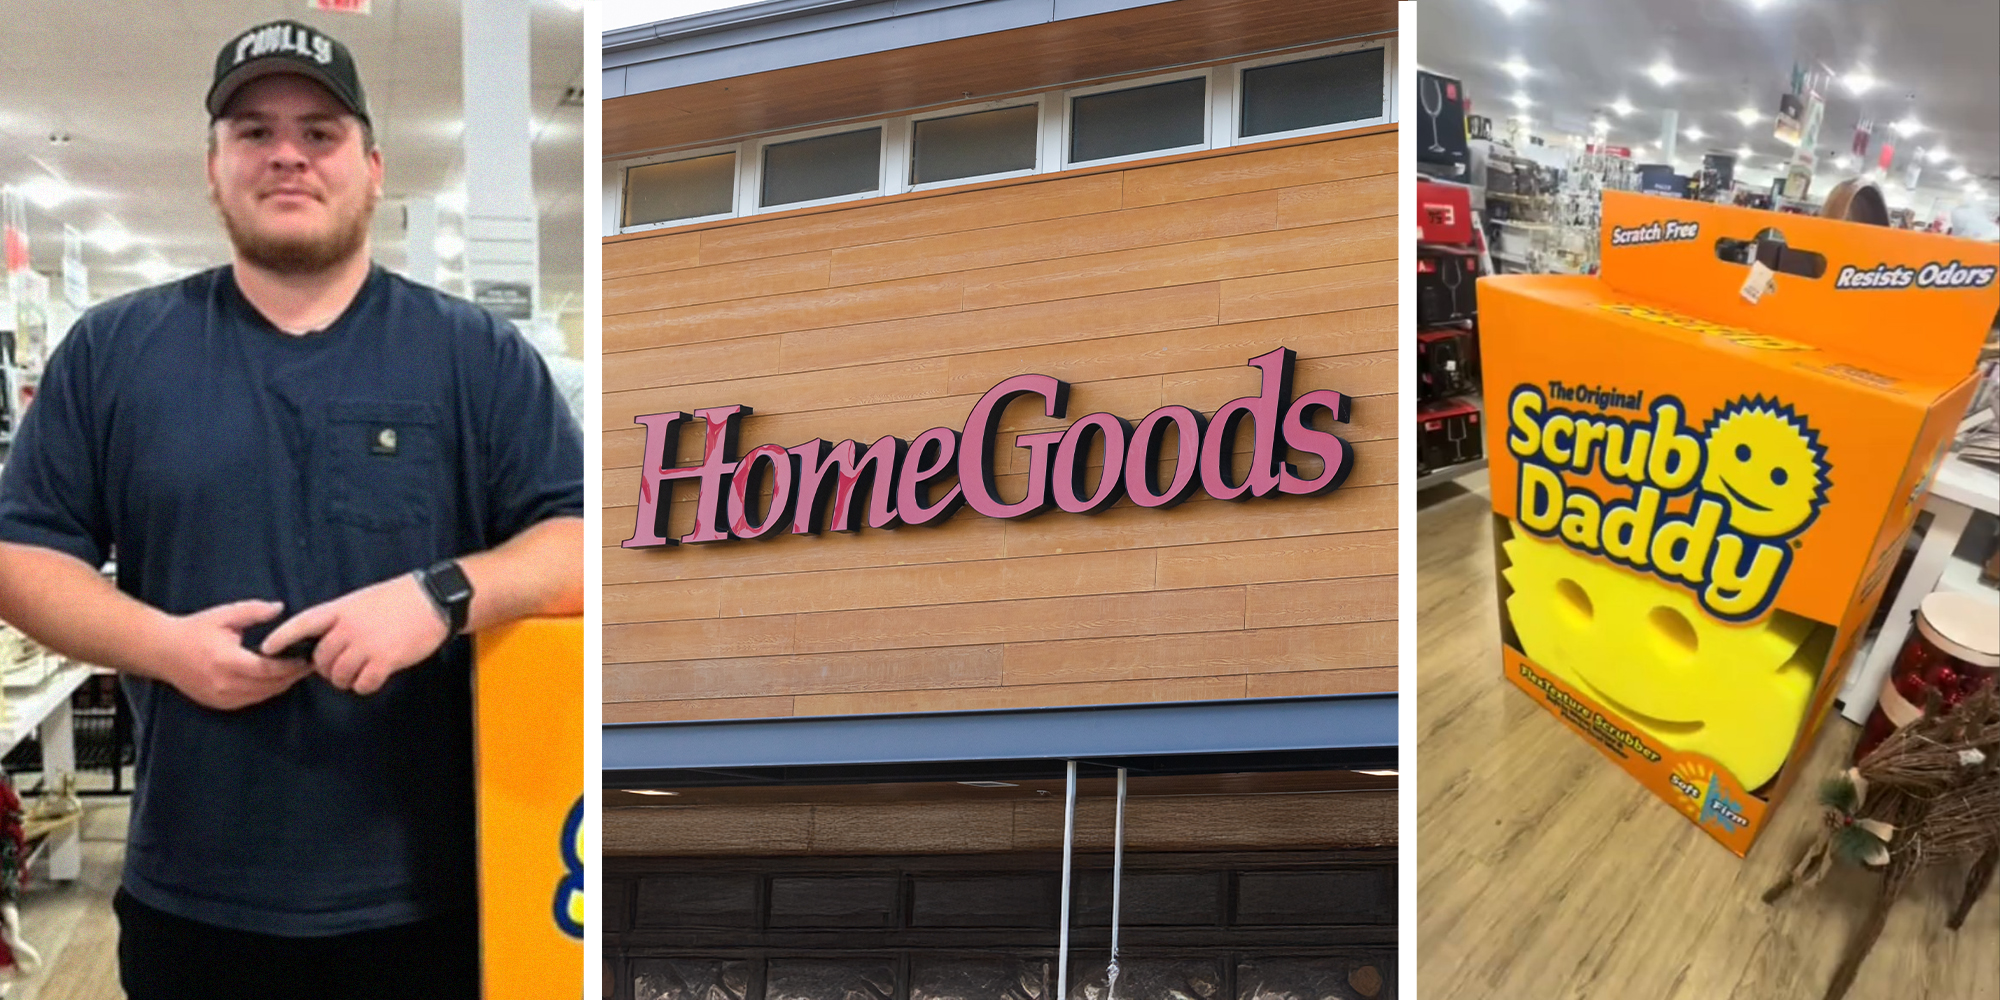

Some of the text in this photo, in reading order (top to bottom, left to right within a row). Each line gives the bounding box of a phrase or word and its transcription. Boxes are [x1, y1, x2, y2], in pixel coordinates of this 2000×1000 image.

[1612, 220, 1700, 245] Scratch Free
[1835, 260, 1996, 289] Resists Odors
[1549, 381, 1643, 411] The Original
[621, 346, 1353, 549] HomeGoods
[1508, 385, 1702, 492] Scrub
[1518, 461, 1788, 618] Daddy
[1593, 712, 1661, 762] Scrubber
[1669, 773, 1702, 800] Soft
[1711, 799, 1750, 828] Firm
